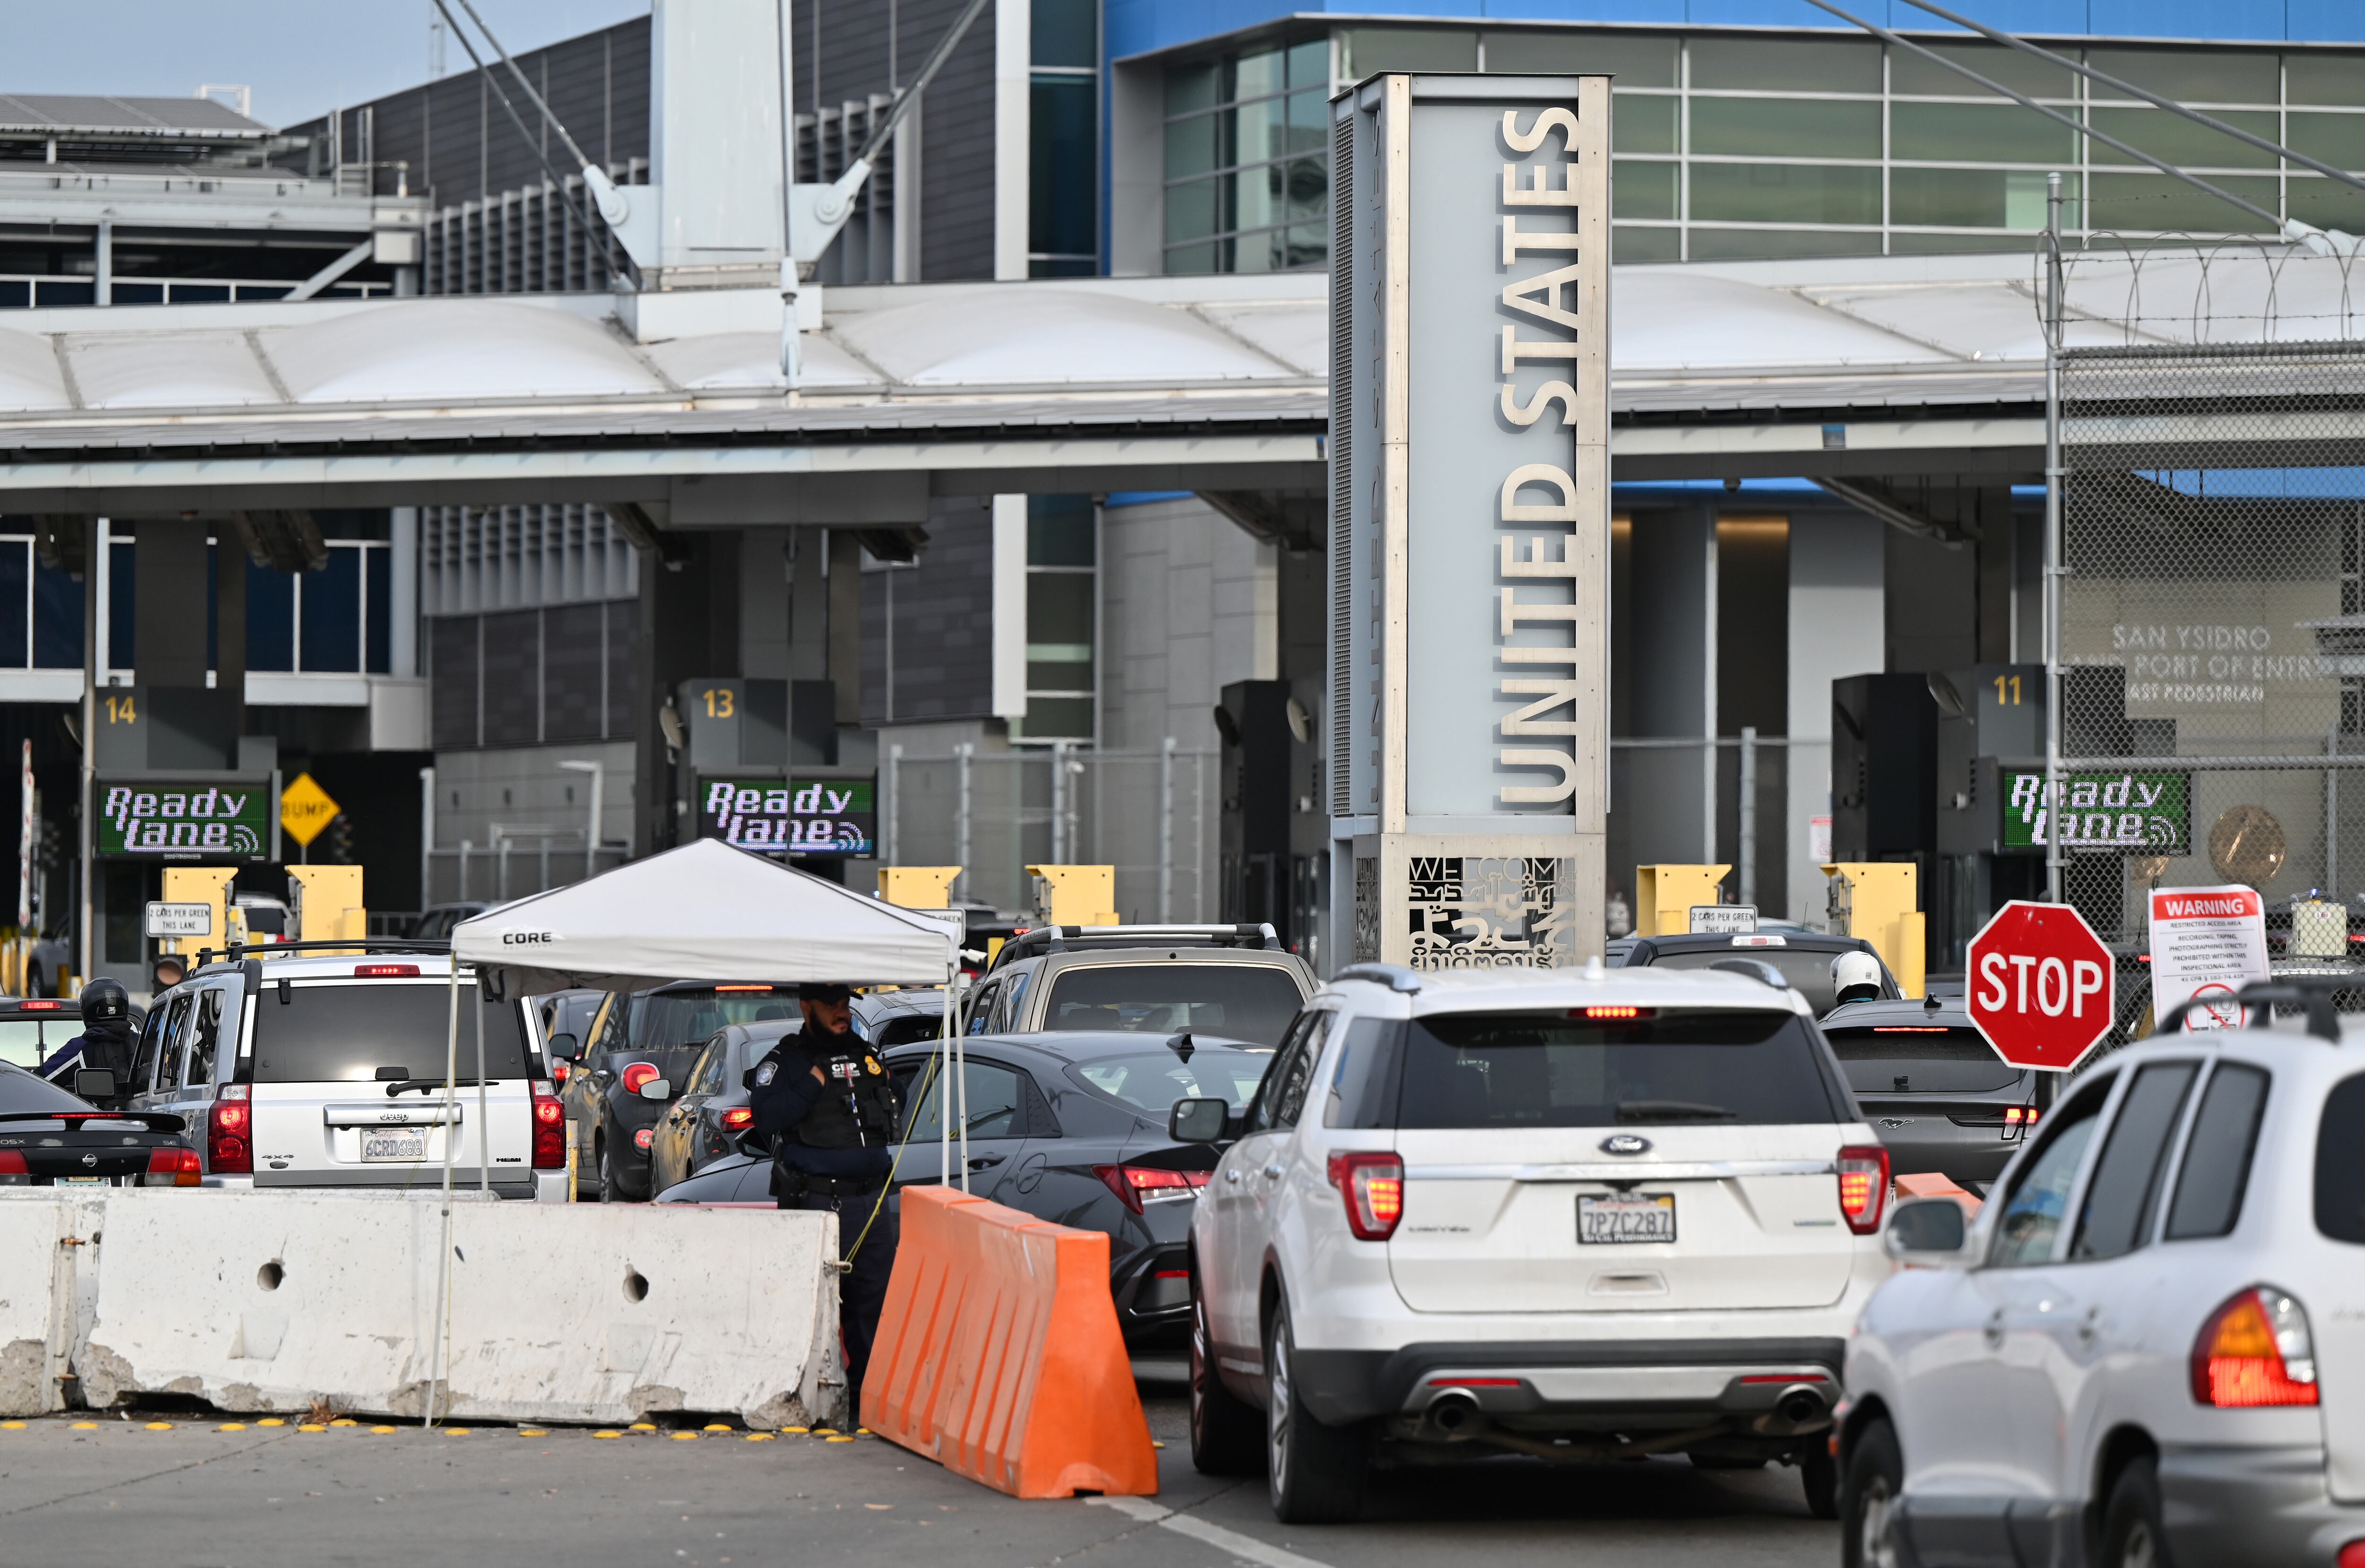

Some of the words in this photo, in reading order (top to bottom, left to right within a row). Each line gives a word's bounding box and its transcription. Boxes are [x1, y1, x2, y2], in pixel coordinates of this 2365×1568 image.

[1501, 107, 1578, 426] STATES
[1500, 463, 1577, 802] UNITED
[2112, 624, 2167, 650] SAN
[2176, 625, 2271, 651] YSIDRO
[2134, 653, 2200, 679] PORT
[2207, 654, 2245, 680] OF
[2251, 654, 2321, 681] ENTR
[703, 688, 735, 718] 13
[1994, 674, 2021, 706] 11
[2128, 683, 2158, 703] AST
[2164, 684, 2264, 703] PEDESTRIAN
[105, 696, 137, 724] 14
[105, 787, 246, 831] Ready
[281, 801, 329, 819] BUMP
[707, 783, 852, 828] Ready
[124, 819, 233, 852] Lane
[1409, 856, 1576, 882] WELCOME
[149, 908, 154, 917] 2
[156, 908, 172, 917] CARS
[174, 909, 186, 917] PER
[189, 909, 210, 918] GREEN
[1692, 913, 1697, 921] 2
[1698, 912, 1715, 921] CARS
[1717, 913, 1731, 921] PER
[1733, 913, 1753, 922] GREEN
[2165, 898, 2244, 916] WARNING
[163, 921, 176, 930] THIS
[180, 921, 196, 930] LANE
[503, 932, 552, 944] CORE
[1706, 925, 1719, 933] THIS
[1977, 952, 2103, 1018] STOP
[380, 1113, 409, 1122] Jeep
[366, 1139, 422, 1156] 6CRD688
[1584, 1211, 1669, 1233] 7PZC287
